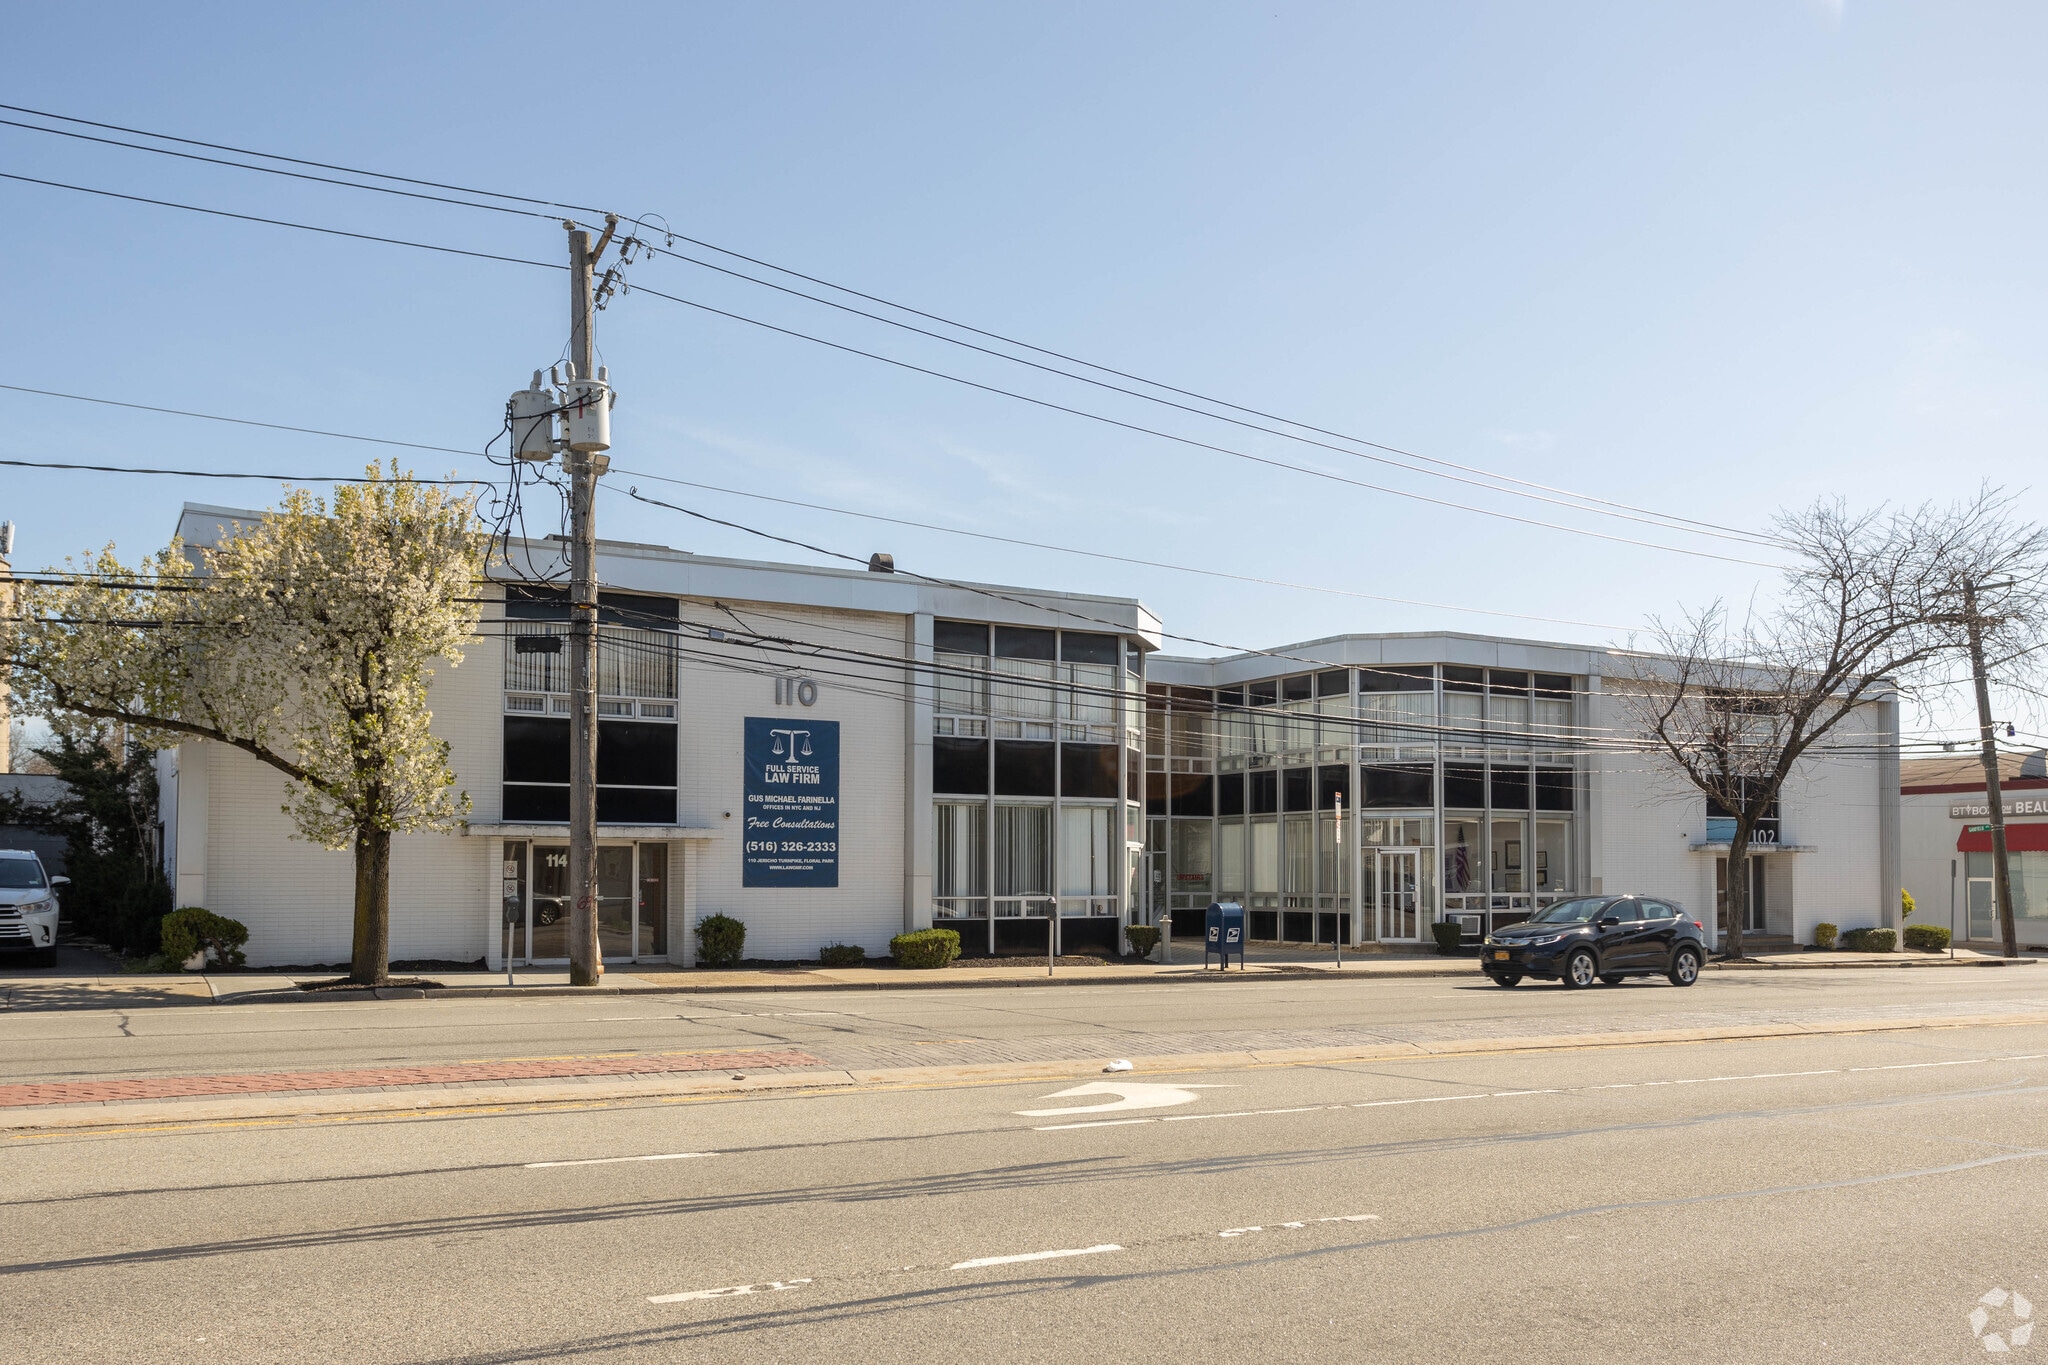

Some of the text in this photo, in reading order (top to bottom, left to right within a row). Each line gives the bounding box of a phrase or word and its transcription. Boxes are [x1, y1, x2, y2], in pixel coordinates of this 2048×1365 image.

[775, 678, 818, 706] 110
[766, 764, 819, 773] FULL SERVICE
[765, 773, 820, 784] LAW FIRM
[748, 794, 835, 804] GUS MICHAEL FARINELLA
[747, 816, 835, 829] Free Consultations
[1753, 829, 1775, 845] 102
[746, 841, 836, 853] (516) 326-2333
[546, 854, 568, 867] 114
